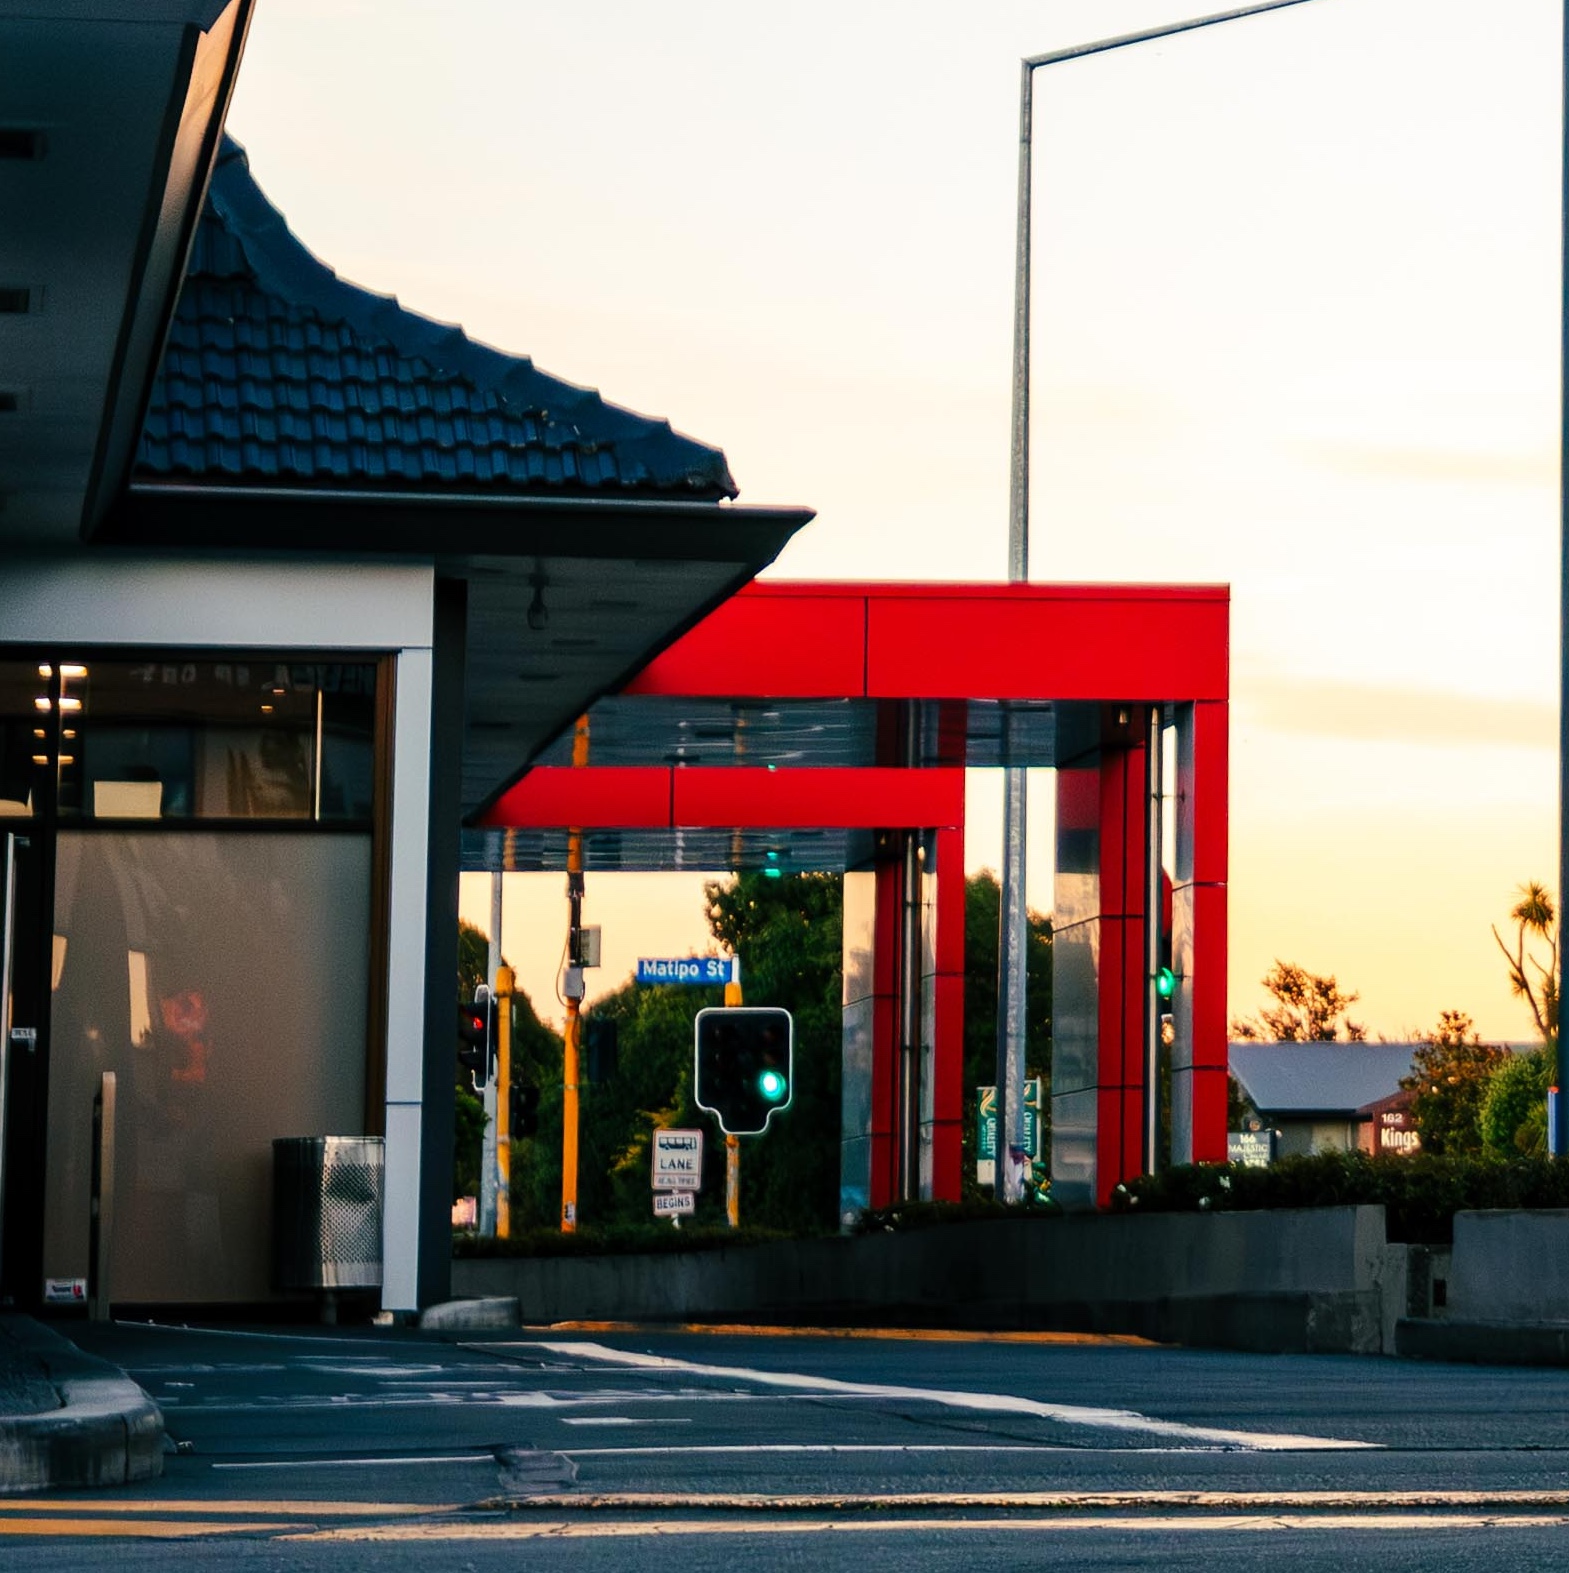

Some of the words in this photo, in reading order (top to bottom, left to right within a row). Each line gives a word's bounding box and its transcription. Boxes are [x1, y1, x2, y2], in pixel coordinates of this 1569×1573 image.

[643, 959, 700, 979] Matipo
[706, 961, 725, 977] St
[1381, 1126, 1420, 1153] Kings
[660, 1158, 693, 1170] LANE
[656, 1196, 691, 1210] BEGINS
